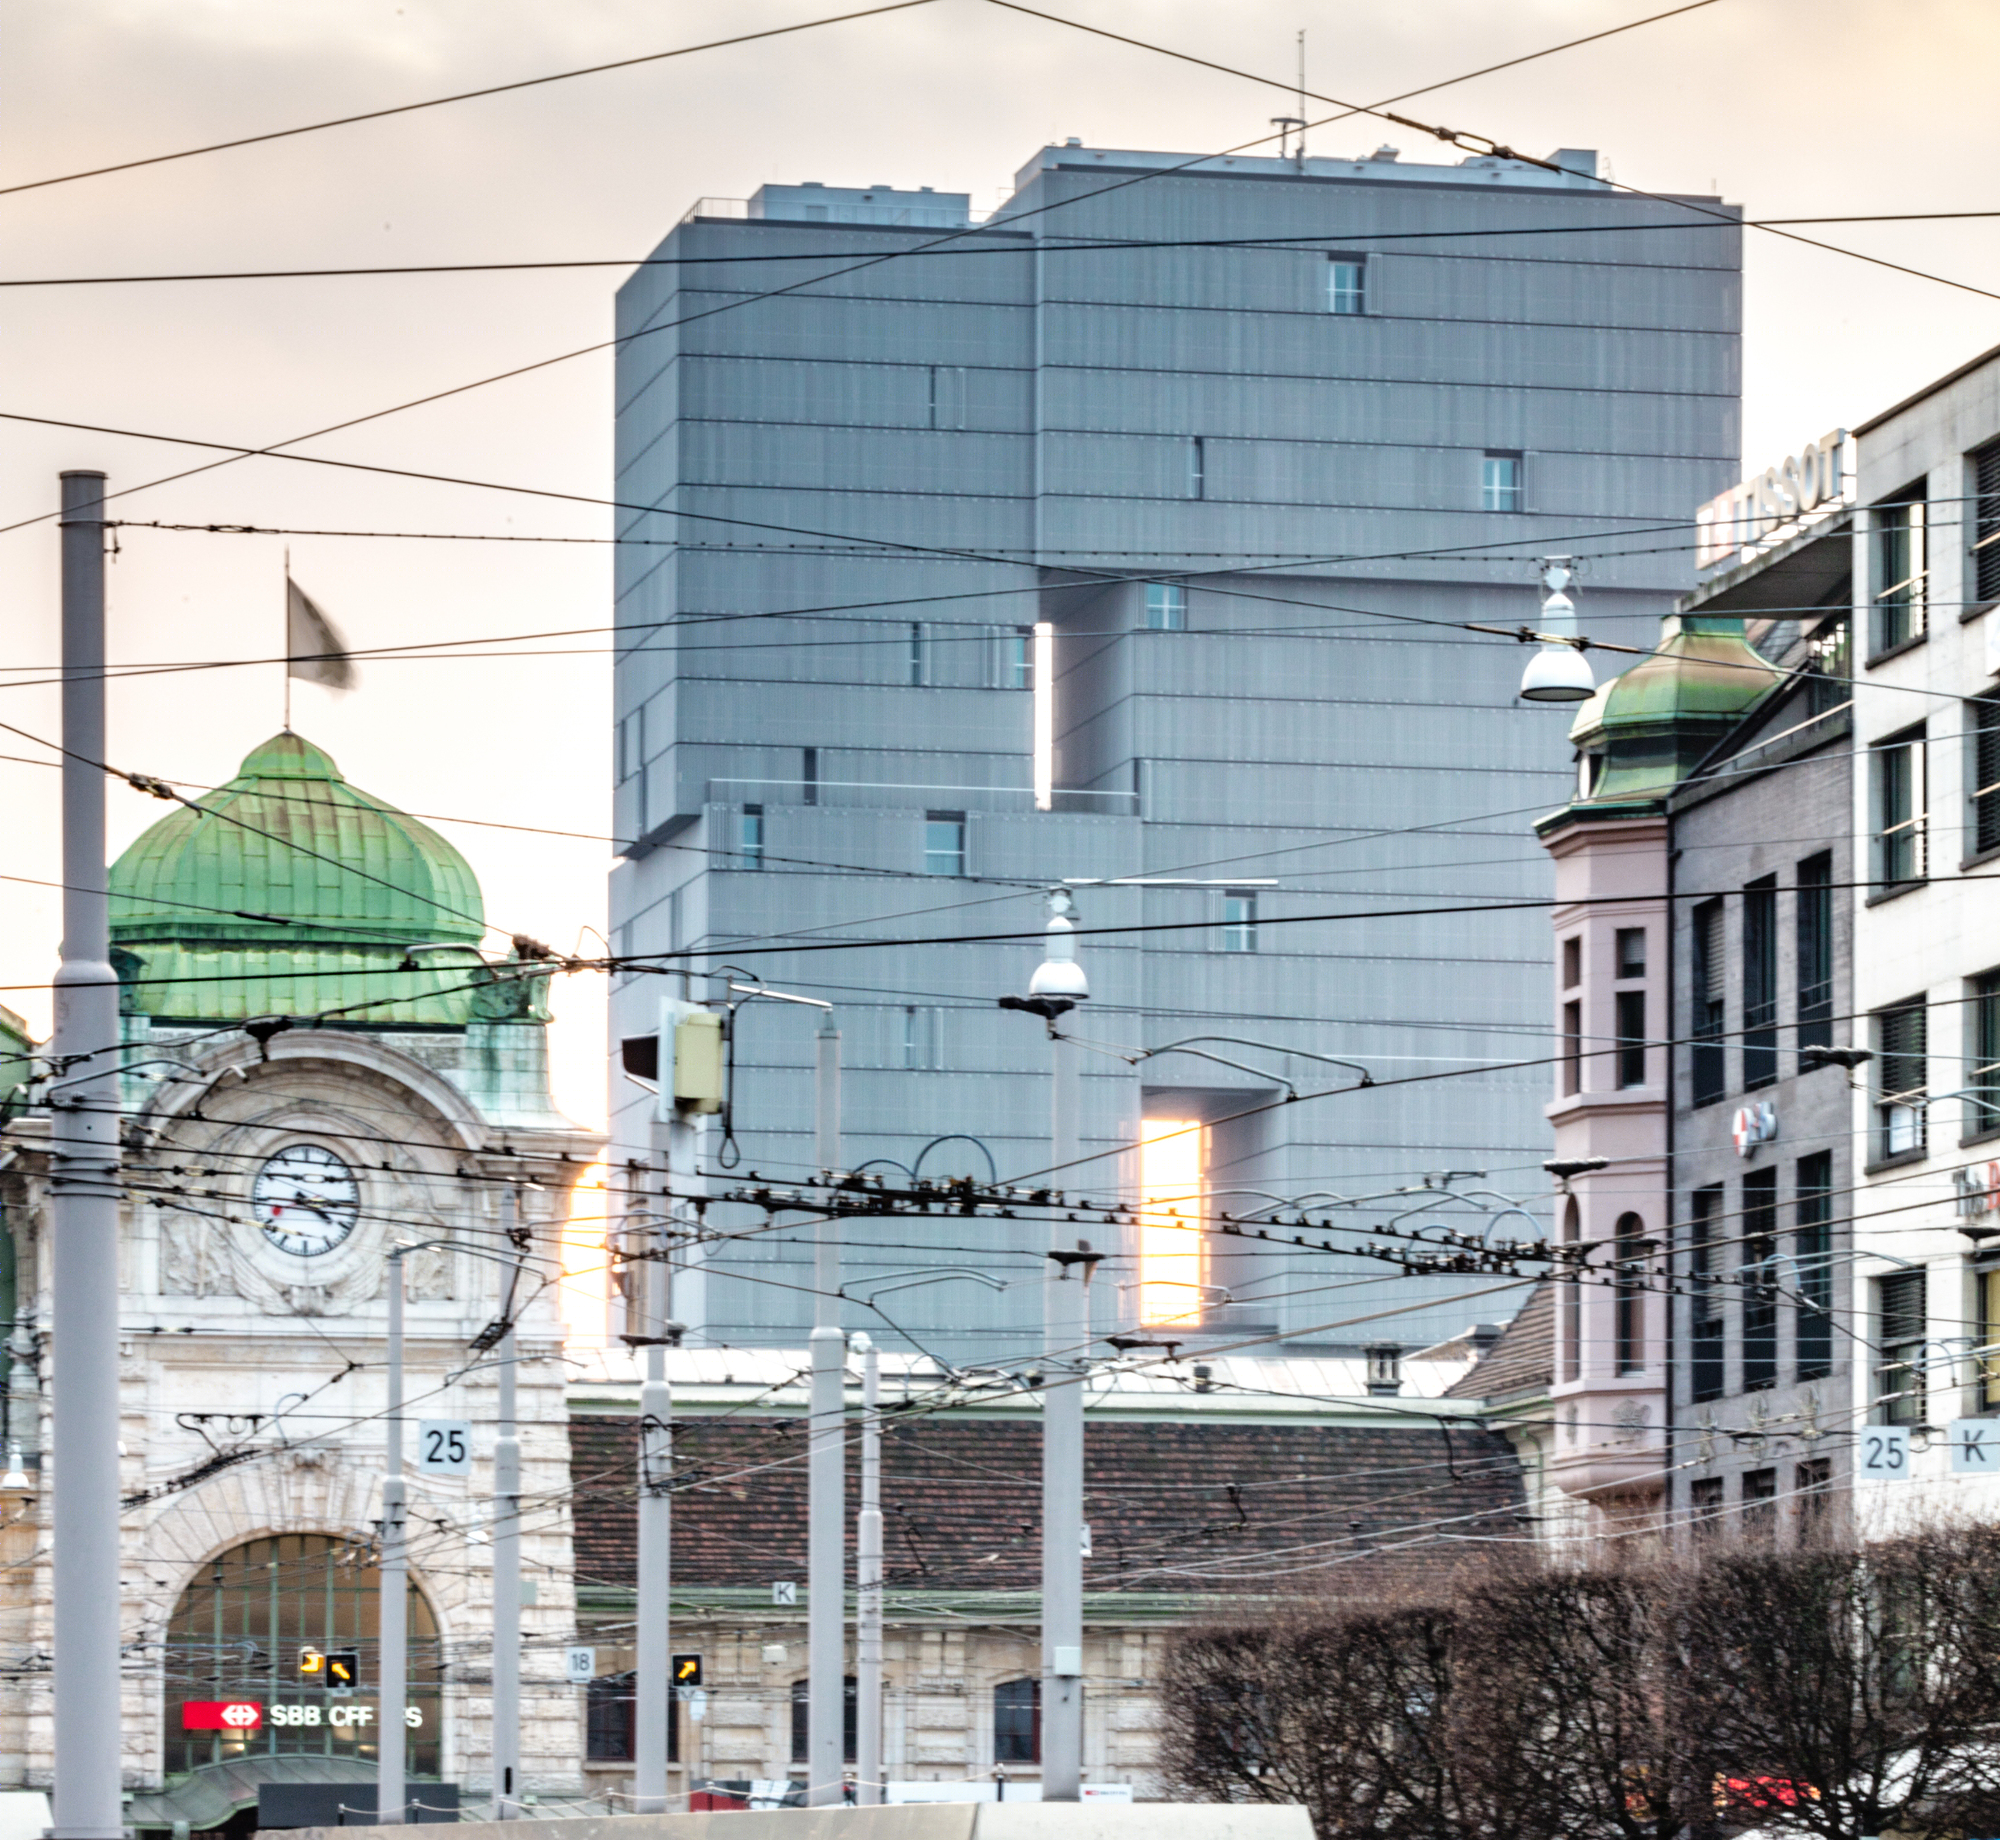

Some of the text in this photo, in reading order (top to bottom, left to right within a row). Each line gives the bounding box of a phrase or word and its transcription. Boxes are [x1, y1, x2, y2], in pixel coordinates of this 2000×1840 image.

[1734, 428, 1845, 544] TISSOT
[426, 1430, 465, 1463] 25
[1866, 1437, 1904, 1469] 25
[1963, 1429, 1986, 1462] K
[778, 1583, 792, 1602] K
[571, 1653, 590, 1671] 18
[270, 1704, 374, 1727] SBB CFF
